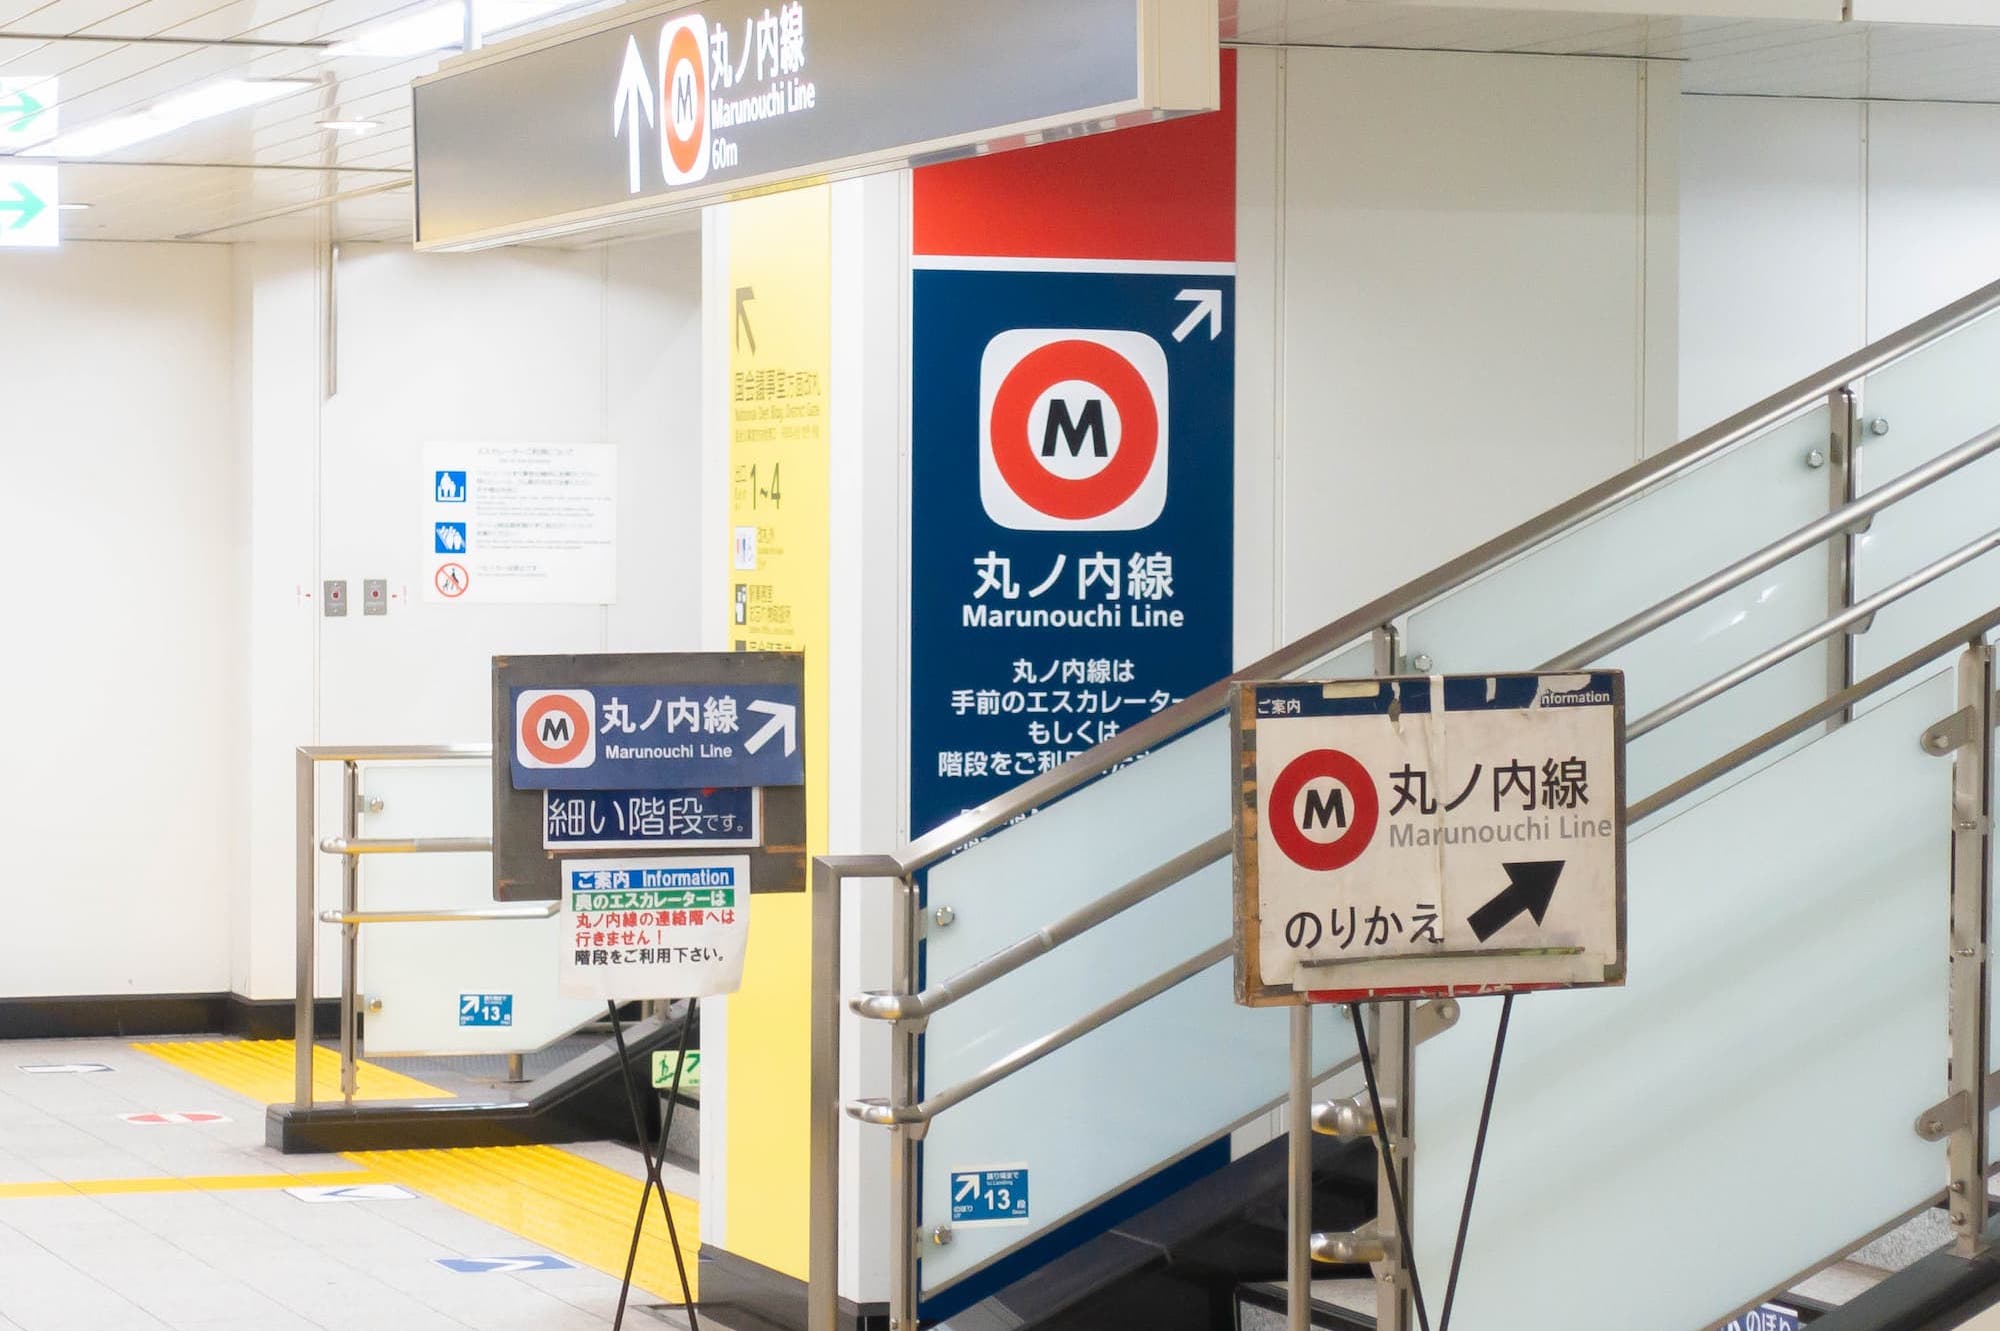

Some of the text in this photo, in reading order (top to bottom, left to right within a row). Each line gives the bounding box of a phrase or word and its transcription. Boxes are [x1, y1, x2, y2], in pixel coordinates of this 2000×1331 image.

[710, 1, 805, 91] 丸ノ内線
[677, 74, 693, 124] M
[711, 77, 816, 130] Marunouchi Line
[711, 137, 738, 170] 60m
[1041, 399, 1108, 457] M
[973, 550, 1174, 600] 丸ノ内線
[962, 604, 1185, 627] Marunouchi Line
[1012, 658, 1135, 684] 丸ノ内線は
[600, 695, 739, 735] 丸ノ内線
[1258, 689, 1610, 715] ご案内 nformation
[542, 718, 569, 741] M
[1028, 720, 1120, 745] もしくは
[605, 743, 733, 760] Marunouchi Line
[1389, 756, 1589, 817] 丸ノ内線
[548, 796, 744, 837] 細い階段です。
[1302, 788, 1346, 829] M
[1389, 814, 1613, 848] Marunouchi Line
[577, 868, 730, 890] ご案内 Information
[575, 890, 726, 911] 奥のエスカレーターは
[576, 909, 735, 929] 丸ノ内線の連絡階へは
[1285, 903, 1444, 949] のりかえ
[575, 947, 724, 966] 階段をご利用下さい。
[481, 1006, 500, 1021] 13
[984, 1188, 1011, 1210] 13
